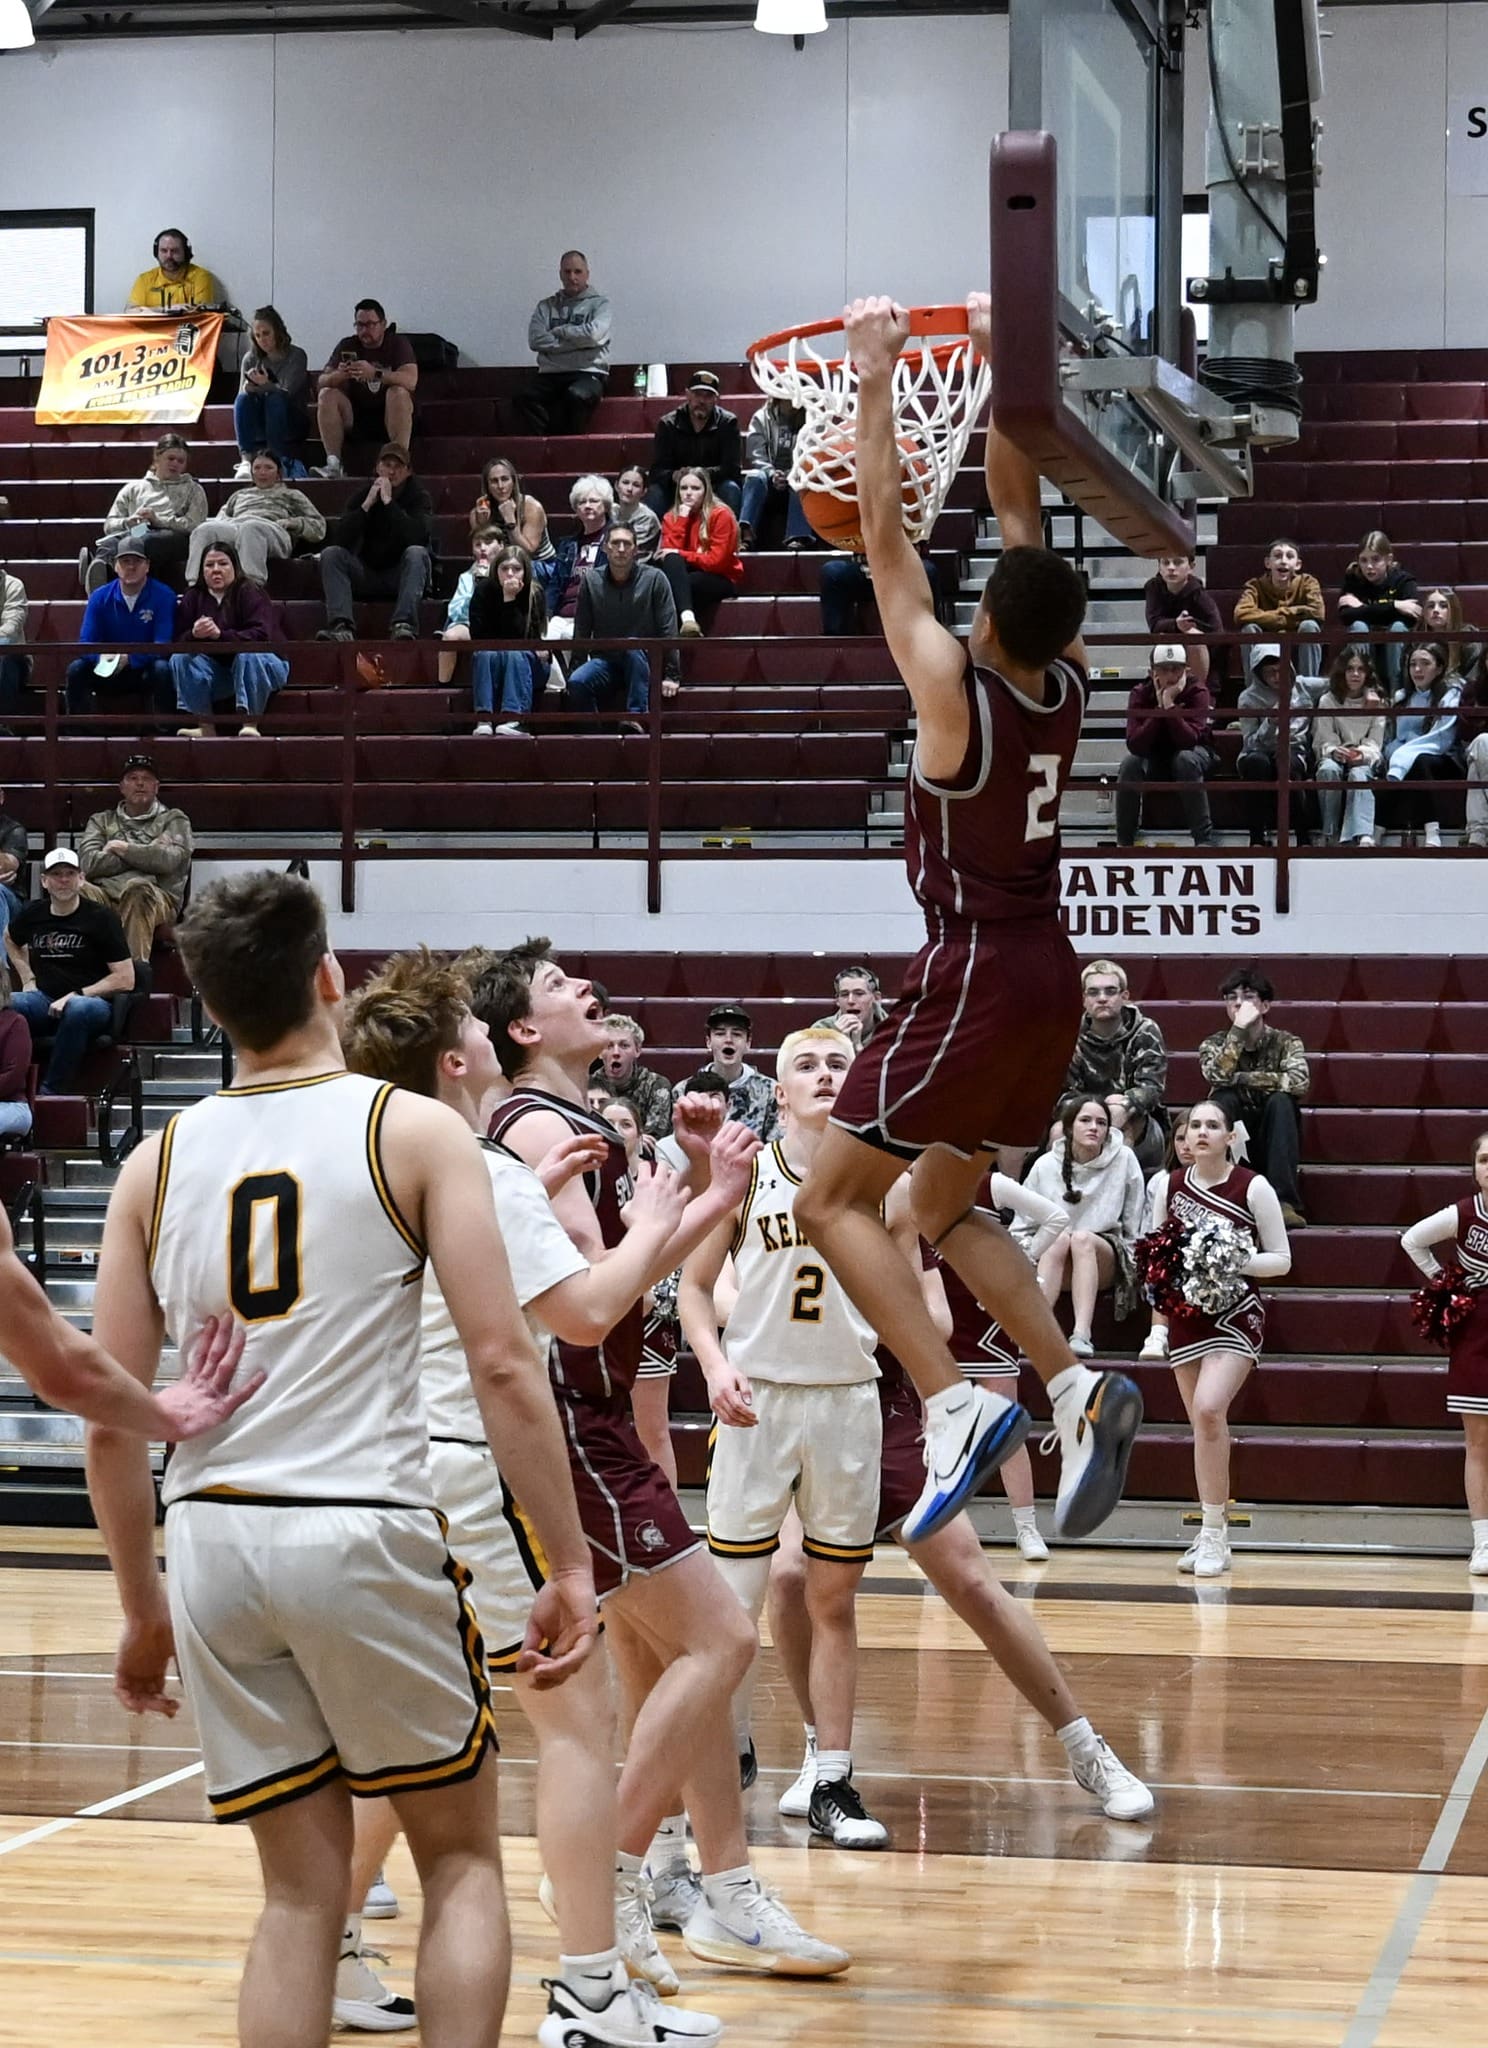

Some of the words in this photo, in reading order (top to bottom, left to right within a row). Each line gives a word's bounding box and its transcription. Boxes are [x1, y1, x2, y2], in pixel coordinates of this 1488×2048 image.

[79, 345, 147, 379] 101.3
[149, 346, 168, 358] FM
[118, 358, 178, 389] 1490
[1024, 754, 1061, 843] 2
[226, 1168, 304, 1325] 0
[790, 1264, 827, 1323] 2
